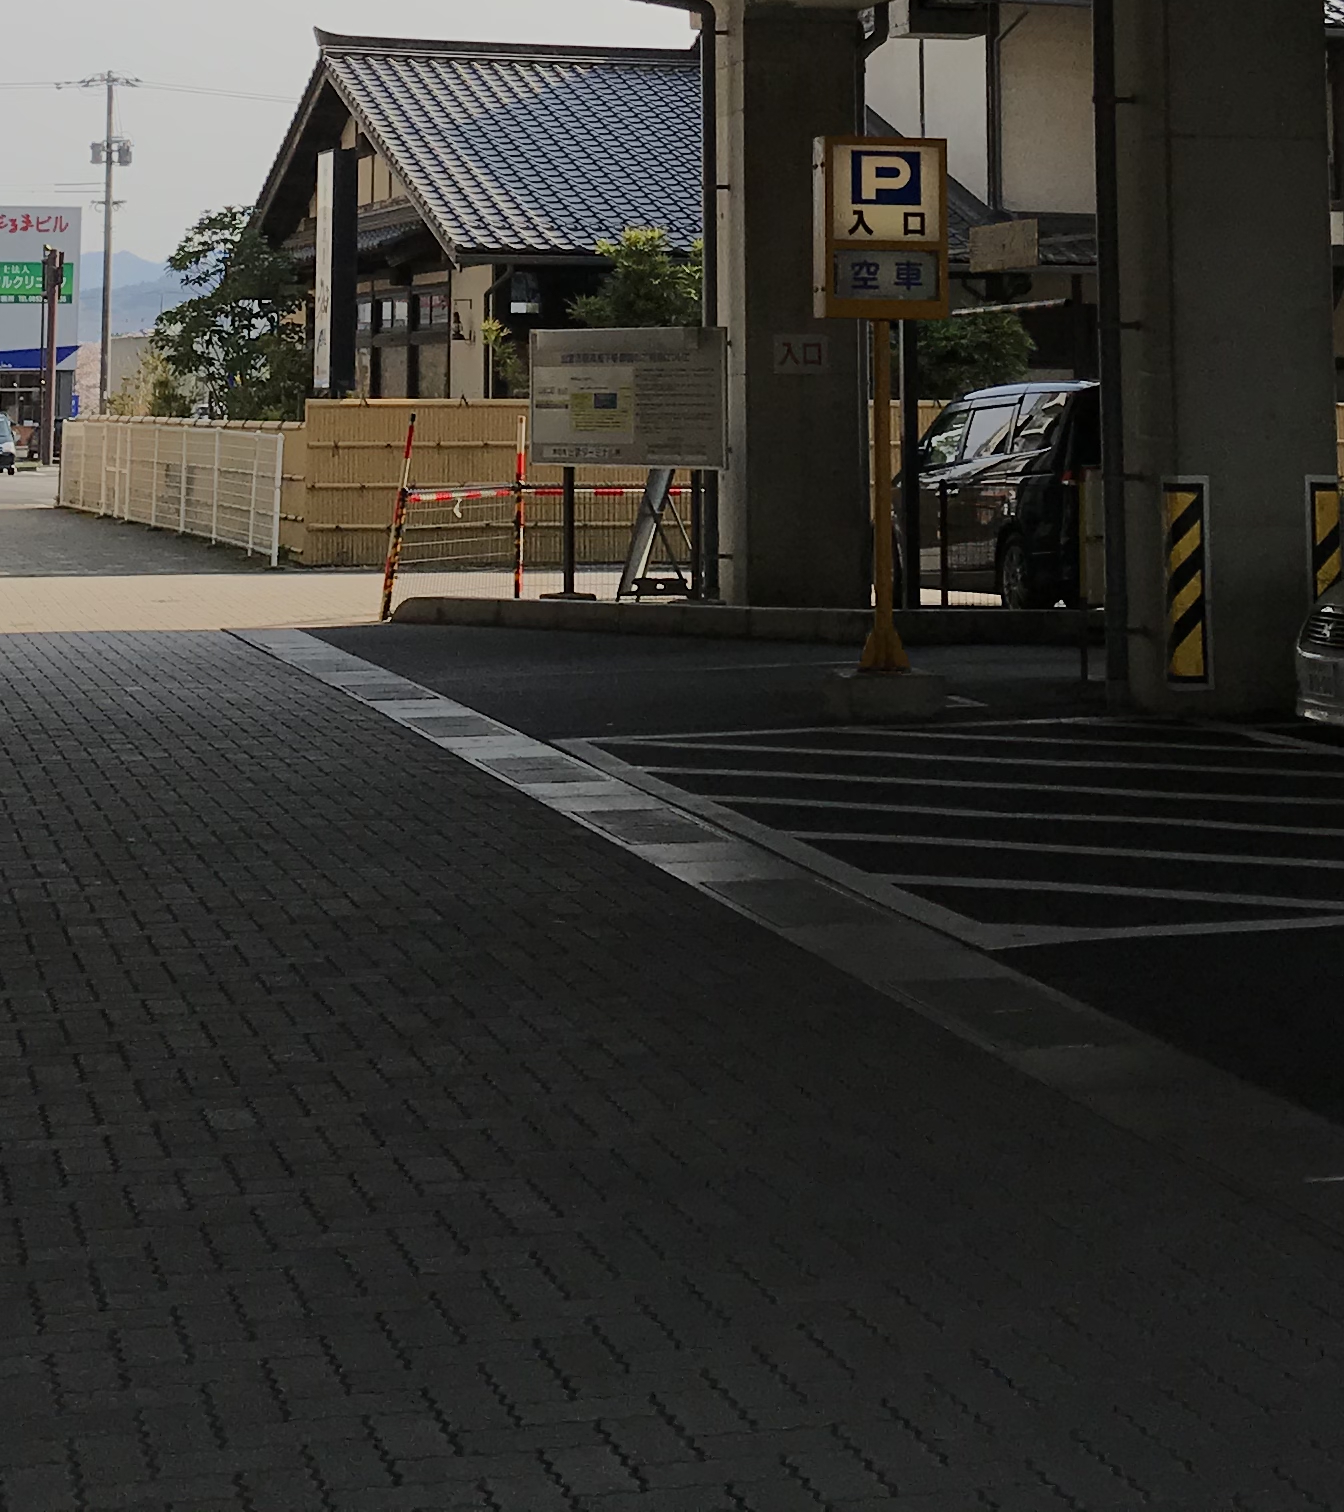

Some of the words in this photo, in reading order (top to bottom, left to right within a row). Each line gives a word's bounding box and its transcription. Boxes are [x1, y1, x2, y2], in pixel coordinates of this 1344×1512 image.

[861, 155, 912, 200] P
[848, 210, 925, 236] 入口
[851, 260, 923, 290] 空車
[777, 341, 823, 366] 入口
